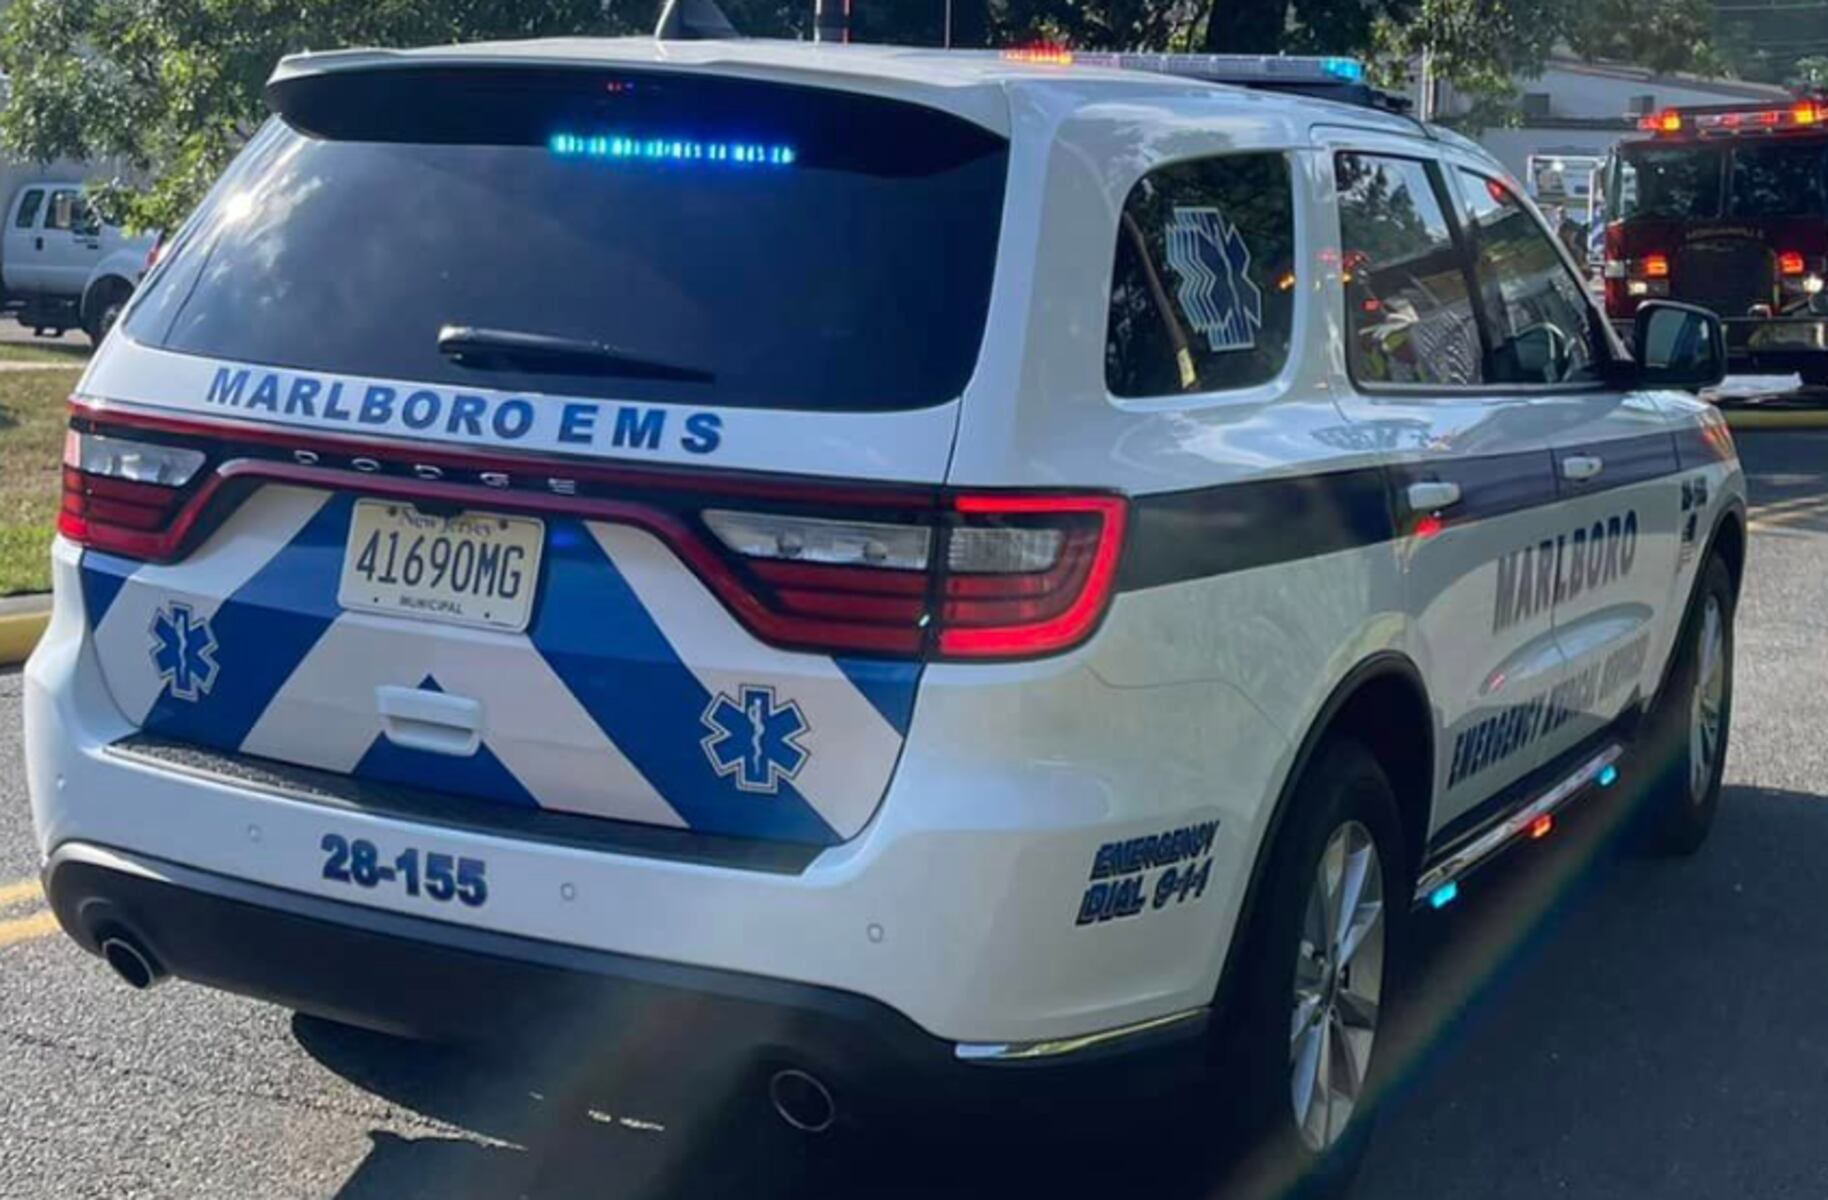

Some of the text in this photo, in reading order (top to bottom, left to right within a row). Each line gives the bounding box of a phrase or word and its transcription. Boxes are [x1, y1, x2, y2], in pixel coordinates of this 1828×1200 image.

[206, 366, 724, 454] MARLBORO EMS
[355, 528, 525, 600] 41690MG
[1493, 509, 1638, 636] MARLBORO
[398, 595, 464, 615] MUNICIPAL
[320, 833, 488, 908] 28-155
[1089, 820, 1221, 882] EMERGENCY
[1075, 875, 1147, 926] DIAL
